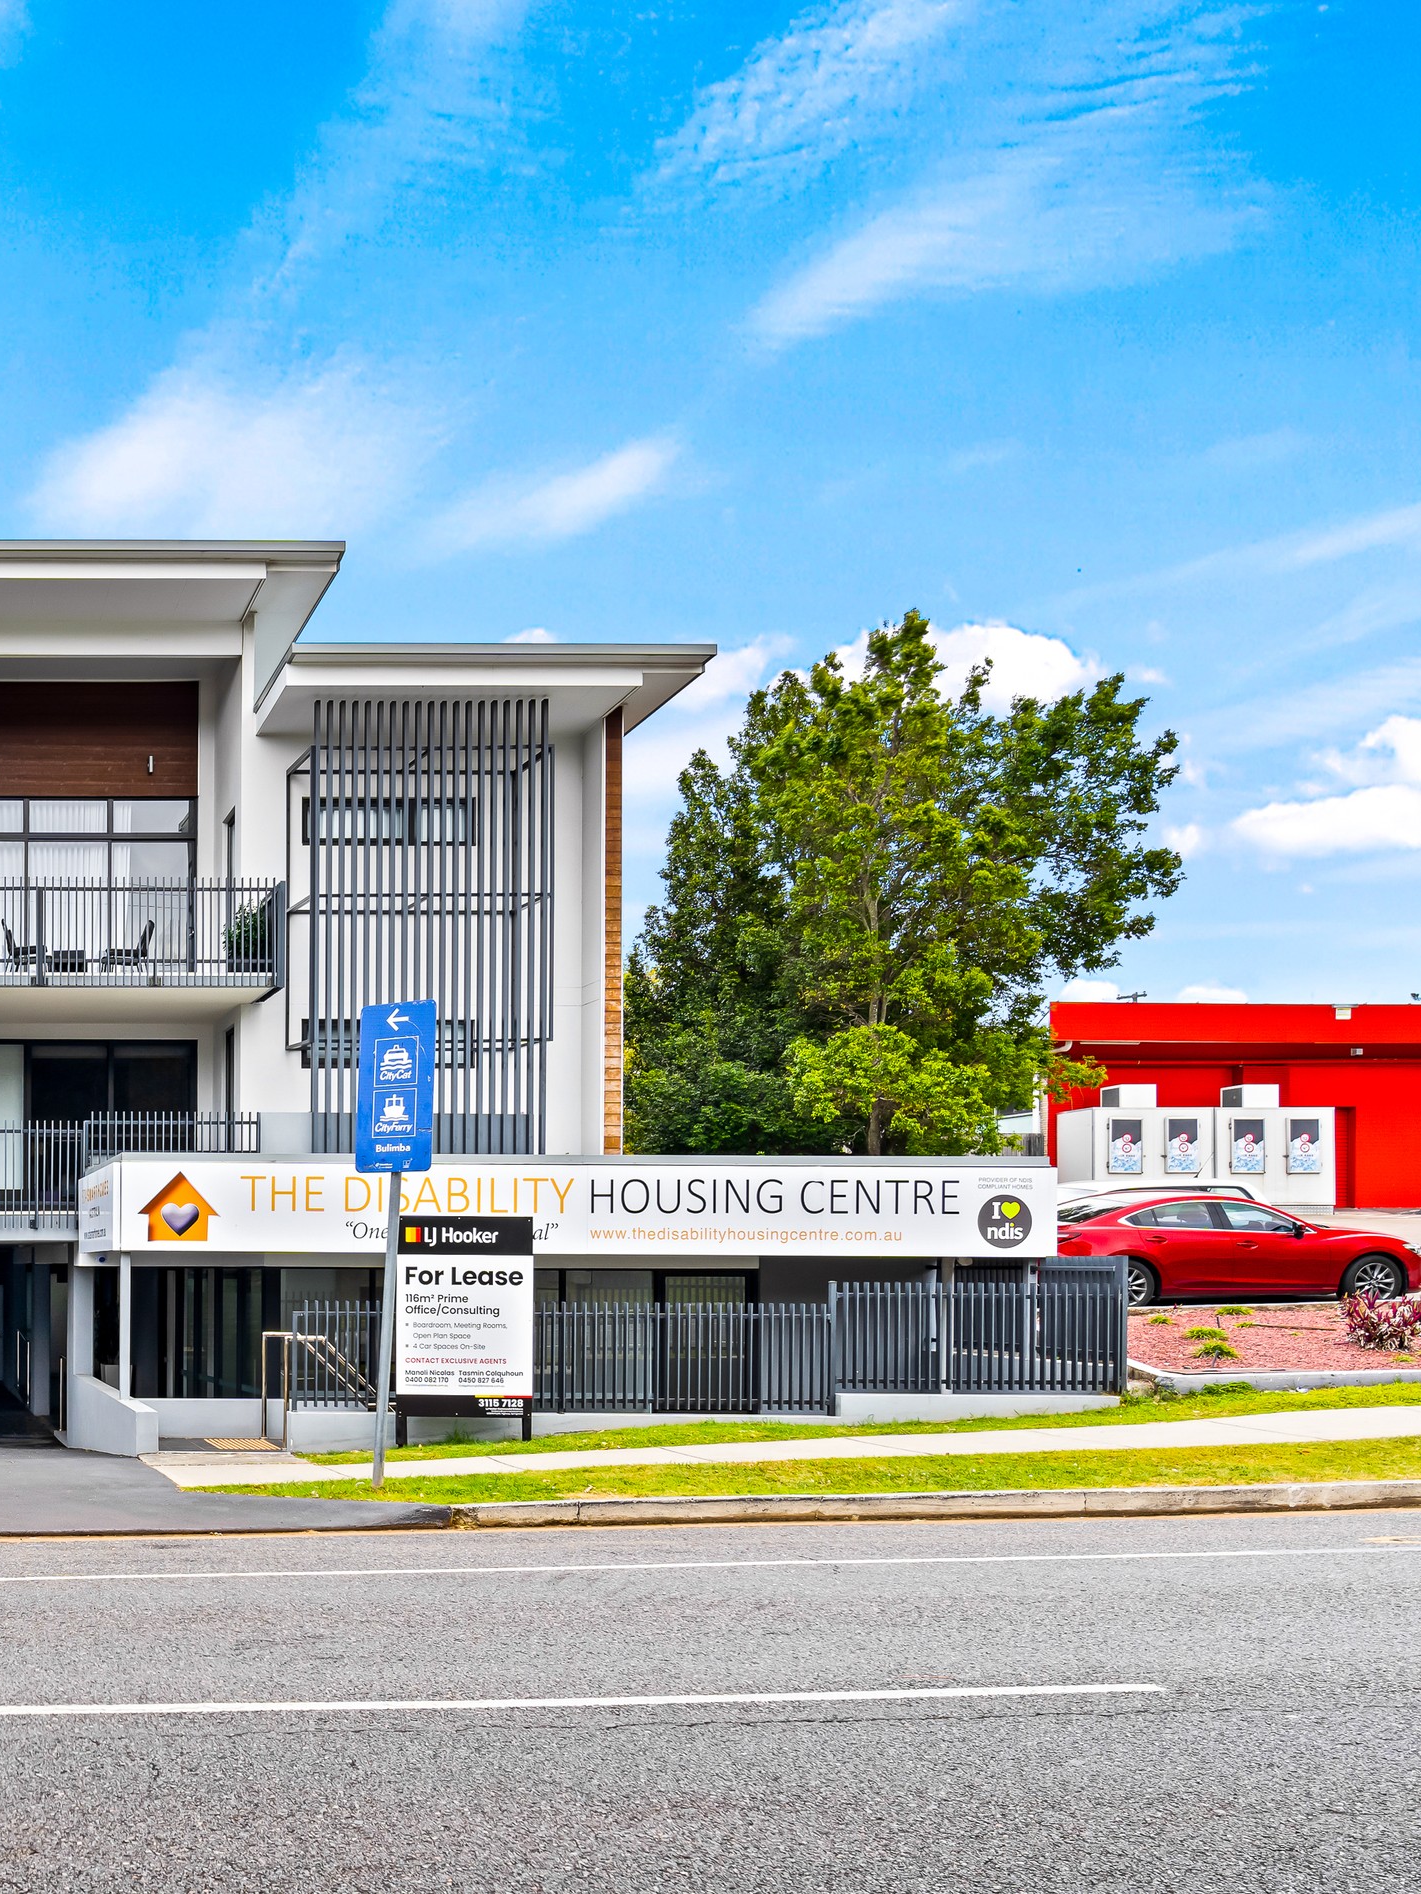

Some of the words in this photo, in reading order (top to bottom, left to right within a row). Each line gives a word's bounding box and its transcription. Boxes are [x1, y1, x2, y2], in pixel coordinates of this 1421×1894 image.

[380, 1070, 412, 1081] CityCat
[374, 1122, 413, 1133] CityFerry
[375, 1143, 411, 1153] Bulimba
[240, 1175, 325, 1212] THE
[590, 1178, 783, 1214] HOUSING
[800, 1179, 960, 1215] CENTRE
[423, 1226, 437, 1247] LJ
[441, 1227, 499, 1244] Hooker
[590, 1227, 903, 1244] www.thedisabilityhousingcentre.com.au
[987, 1222, 1024, 1240] ndis
[405, 1266, 444, 1286] For
[451, 1266, 524, 1286] Lease
[437, 1293, 469, 1303] Prime
[405, 1303, 500, 1318] Office/Consulting
[413, 1321, 452, 1329] Boardroom,
[454, 1322, 481, 1330] Meeting
[413, 1332, 432, 1340] Open
[449, 1332, 471, 1340] Space
[433, 1343, 458, 1351] Spaces
[485, 1370, 524, 1378] Colquhoun
[478, 1398, 500, 1408] 3115
[501, 1398, 524, 1408] 7128
